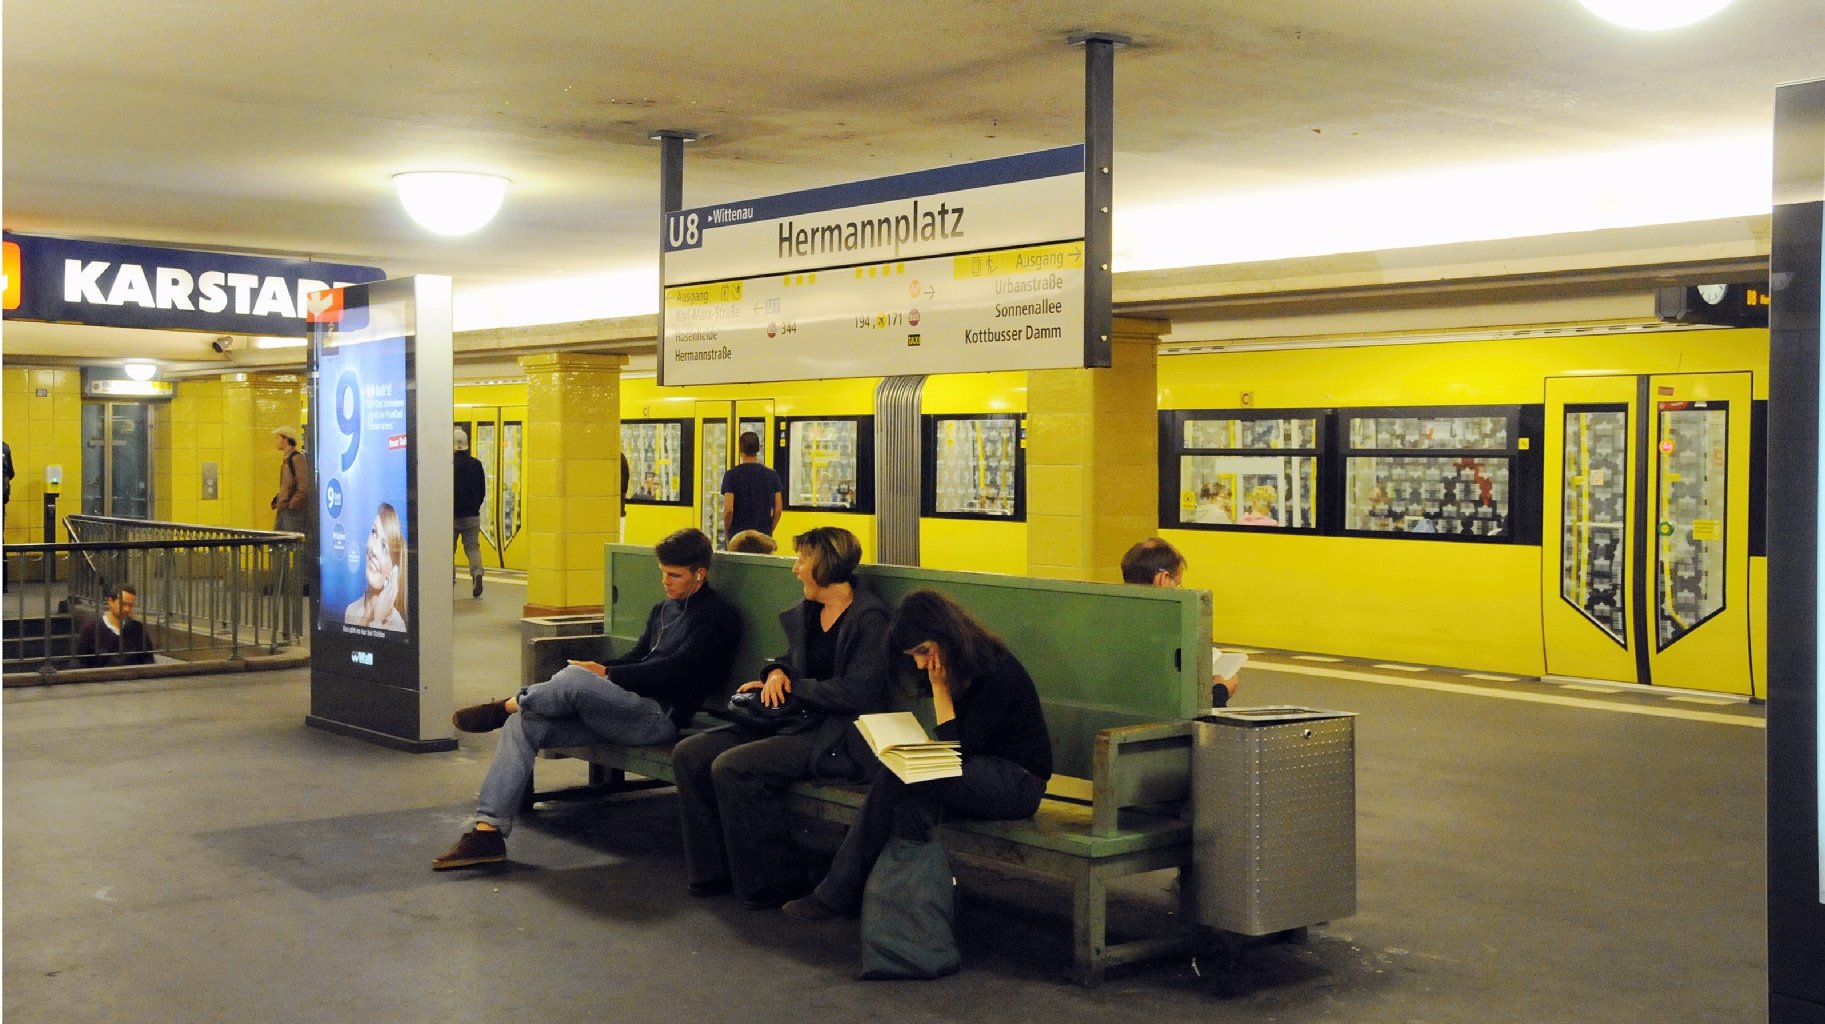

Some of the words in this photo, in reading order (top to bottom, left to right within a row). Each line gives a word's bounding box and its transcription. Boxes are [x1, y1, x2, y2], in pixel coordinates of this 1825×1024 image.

[670, 212, 699, 247] U8
[713, 207, 753, 224] Wittenau
[778, 200, 965, 258] Hermannplatz
[1016, 252, 1064, 270] Ausgang
[64, 259, 357, 318] KARSTA
[995, 273, 1063, 294] Urbanstraße
[676, 291, 709, 304] Ausgang
[995, 299, 1062, 318] Sonnenallee
[781, 322, 797, 334] 344
[888, 312, 902, 326] 171
[965, 328, 1022, 344] Kottbusser
[1026, 325, 1062, 340] Damm
[675, 346, 732, 362] Hermannstraße
[336, 370, 361, 472] 9
[327, 487, 335, 509] 9
